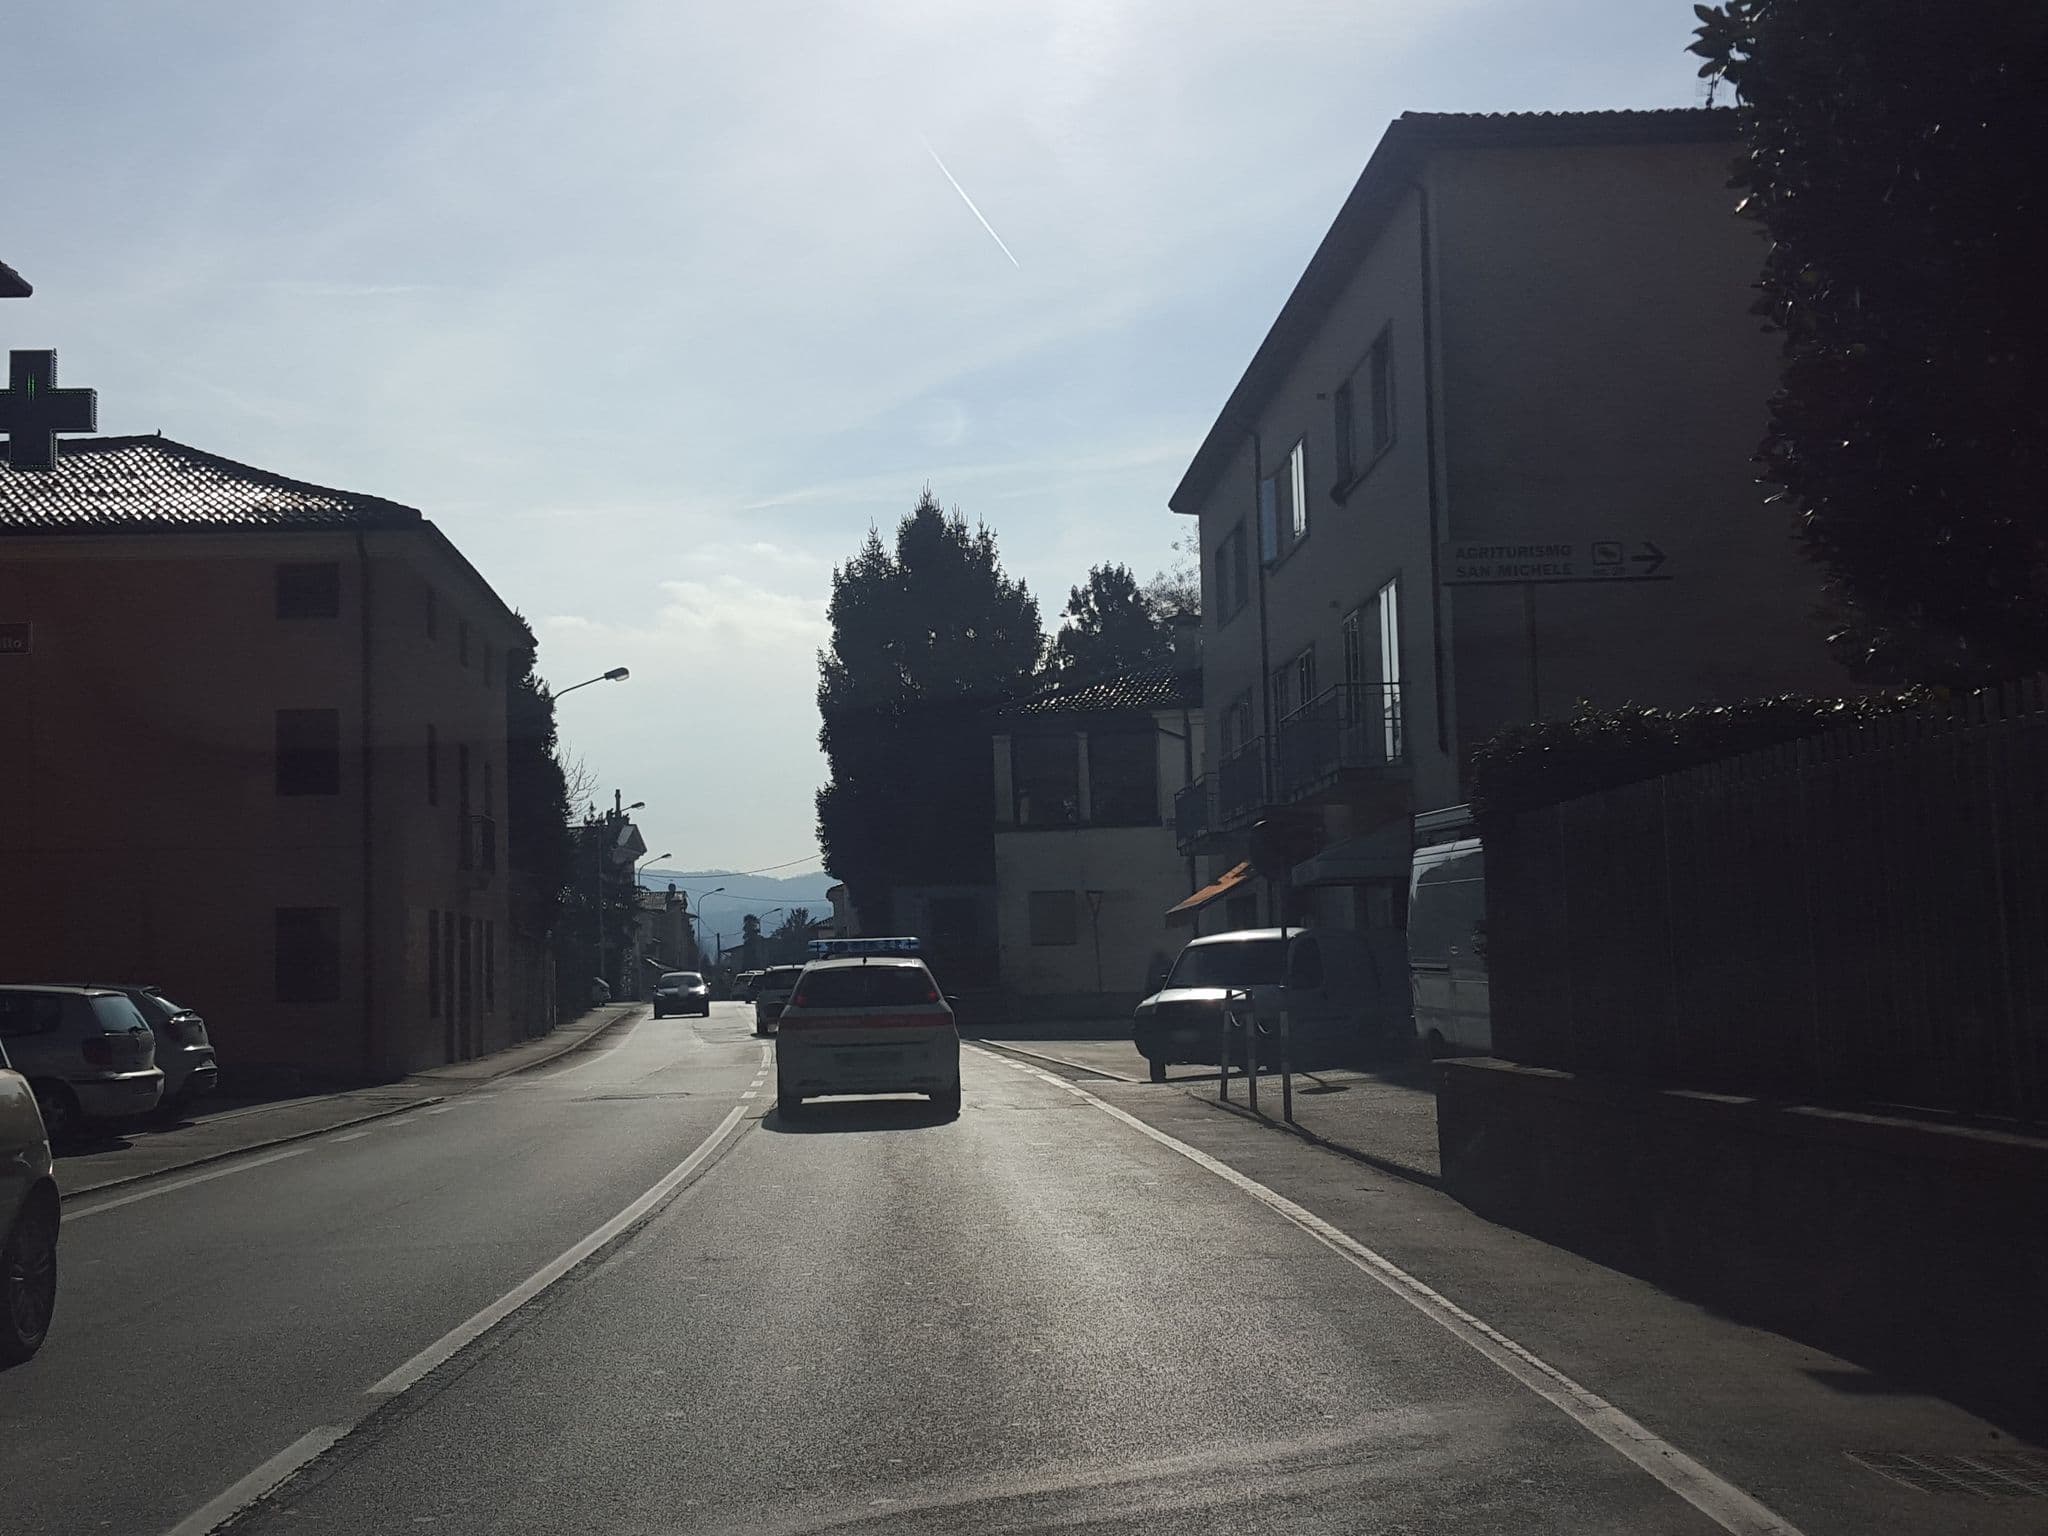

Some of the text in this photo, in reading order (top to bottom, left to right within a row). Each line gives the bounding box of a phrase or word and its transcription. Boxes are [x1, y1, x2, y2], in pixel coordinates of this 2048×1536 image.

[1456, 544, 1571, 560] AGRITURISMO
[1456, 563, 1573, 578] SAN MICHELE
